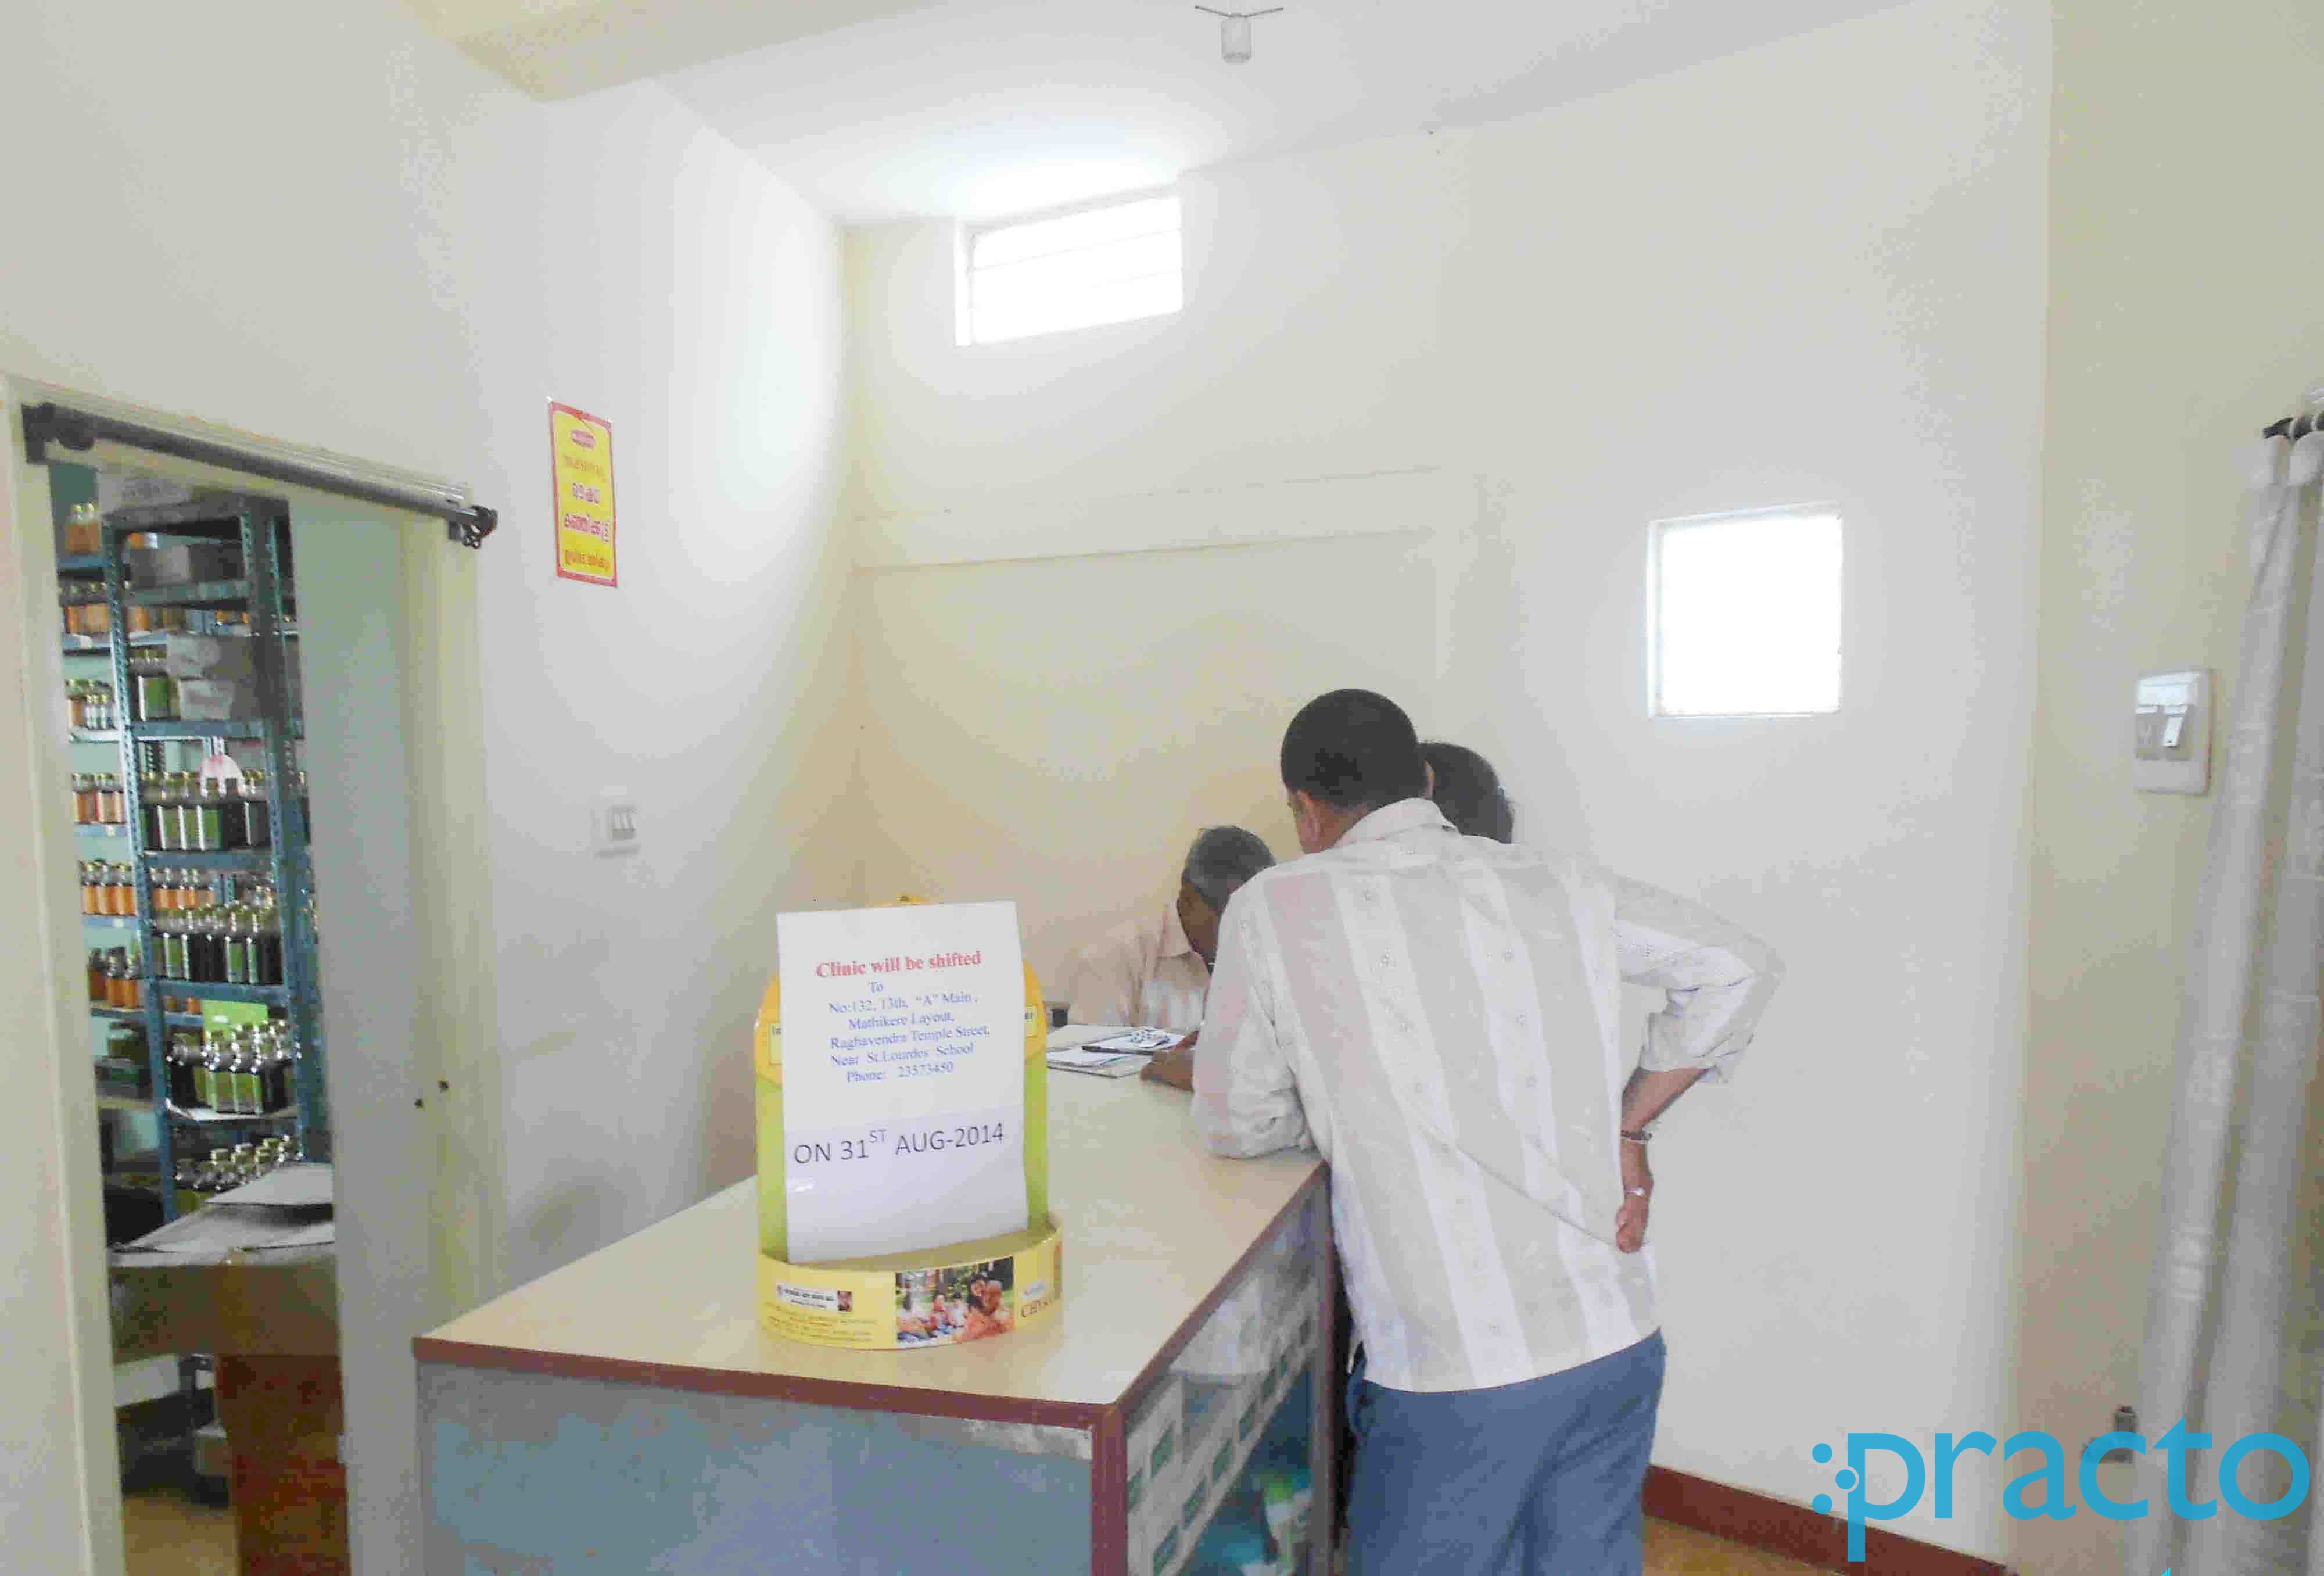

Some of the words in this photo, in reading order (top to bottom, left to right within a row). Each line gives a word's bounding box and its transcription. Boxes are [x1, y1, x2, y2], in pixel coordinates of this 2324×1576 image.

[816, 961, 865, 977] Clinic
[871, 957, 901, 972] will
[906, 957, 924, 970] be
[928, 950, 982, 968] shifted
[869, 982, 884, 993] To
[848, 1015, 907, 1030] Mathikere
[830, 1032, 907, 1051] Raghavendra
[910, 1028, 952, 1042] Temple
[830, 1055, 859, 1066] Near
[936, 1042, 975, 1056] School
[794, 1142, 831, 1164] ON
[895, 1122, 1004, 1155] AUG-2014
